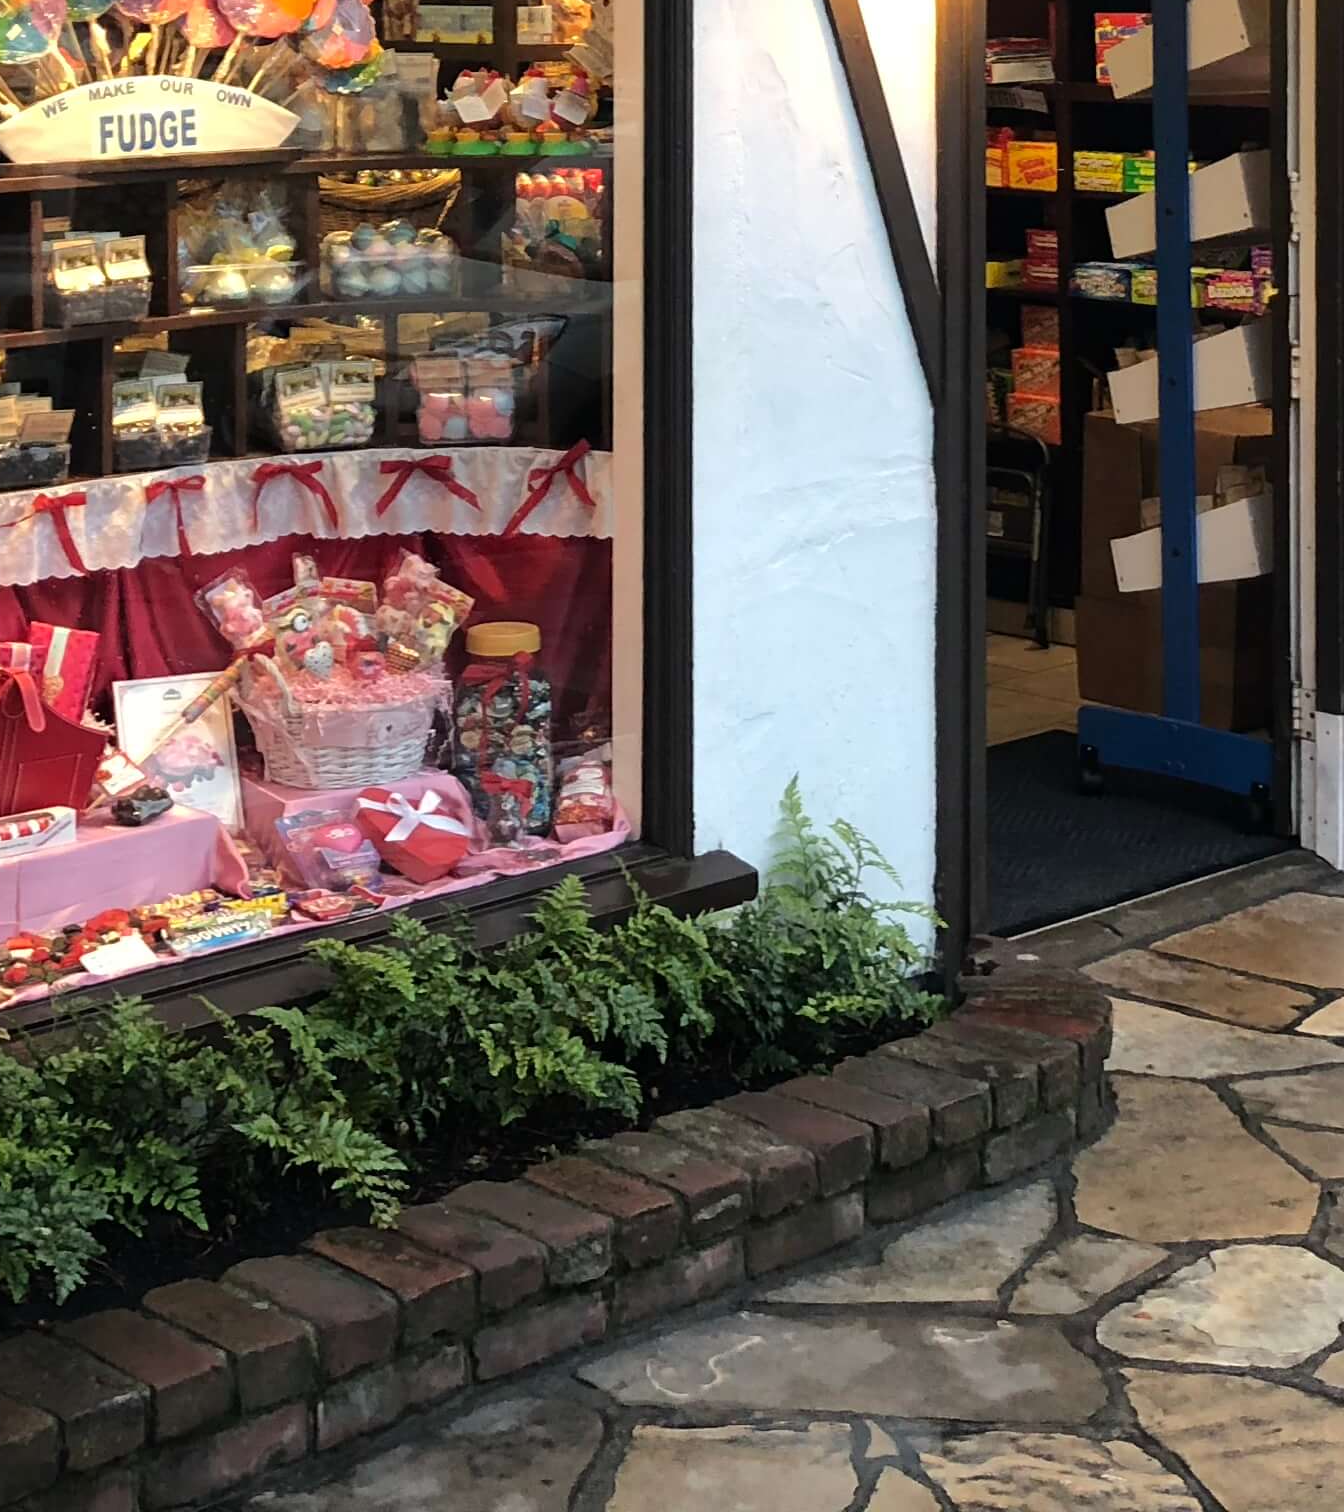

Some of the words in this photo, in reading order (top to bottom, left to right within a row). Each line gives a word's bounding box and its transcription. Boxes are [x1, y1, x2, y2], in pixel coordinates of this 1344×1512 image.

[41, 98, 69, 118] WE
[88, 81, 136, 101] MAKE
[159, 79, 194, 96] OUR
[216, 89, 252, 108] OWN
[99, 109, 198, 154] FUDGE
[190, 920, 251, 943] BOUNTY
